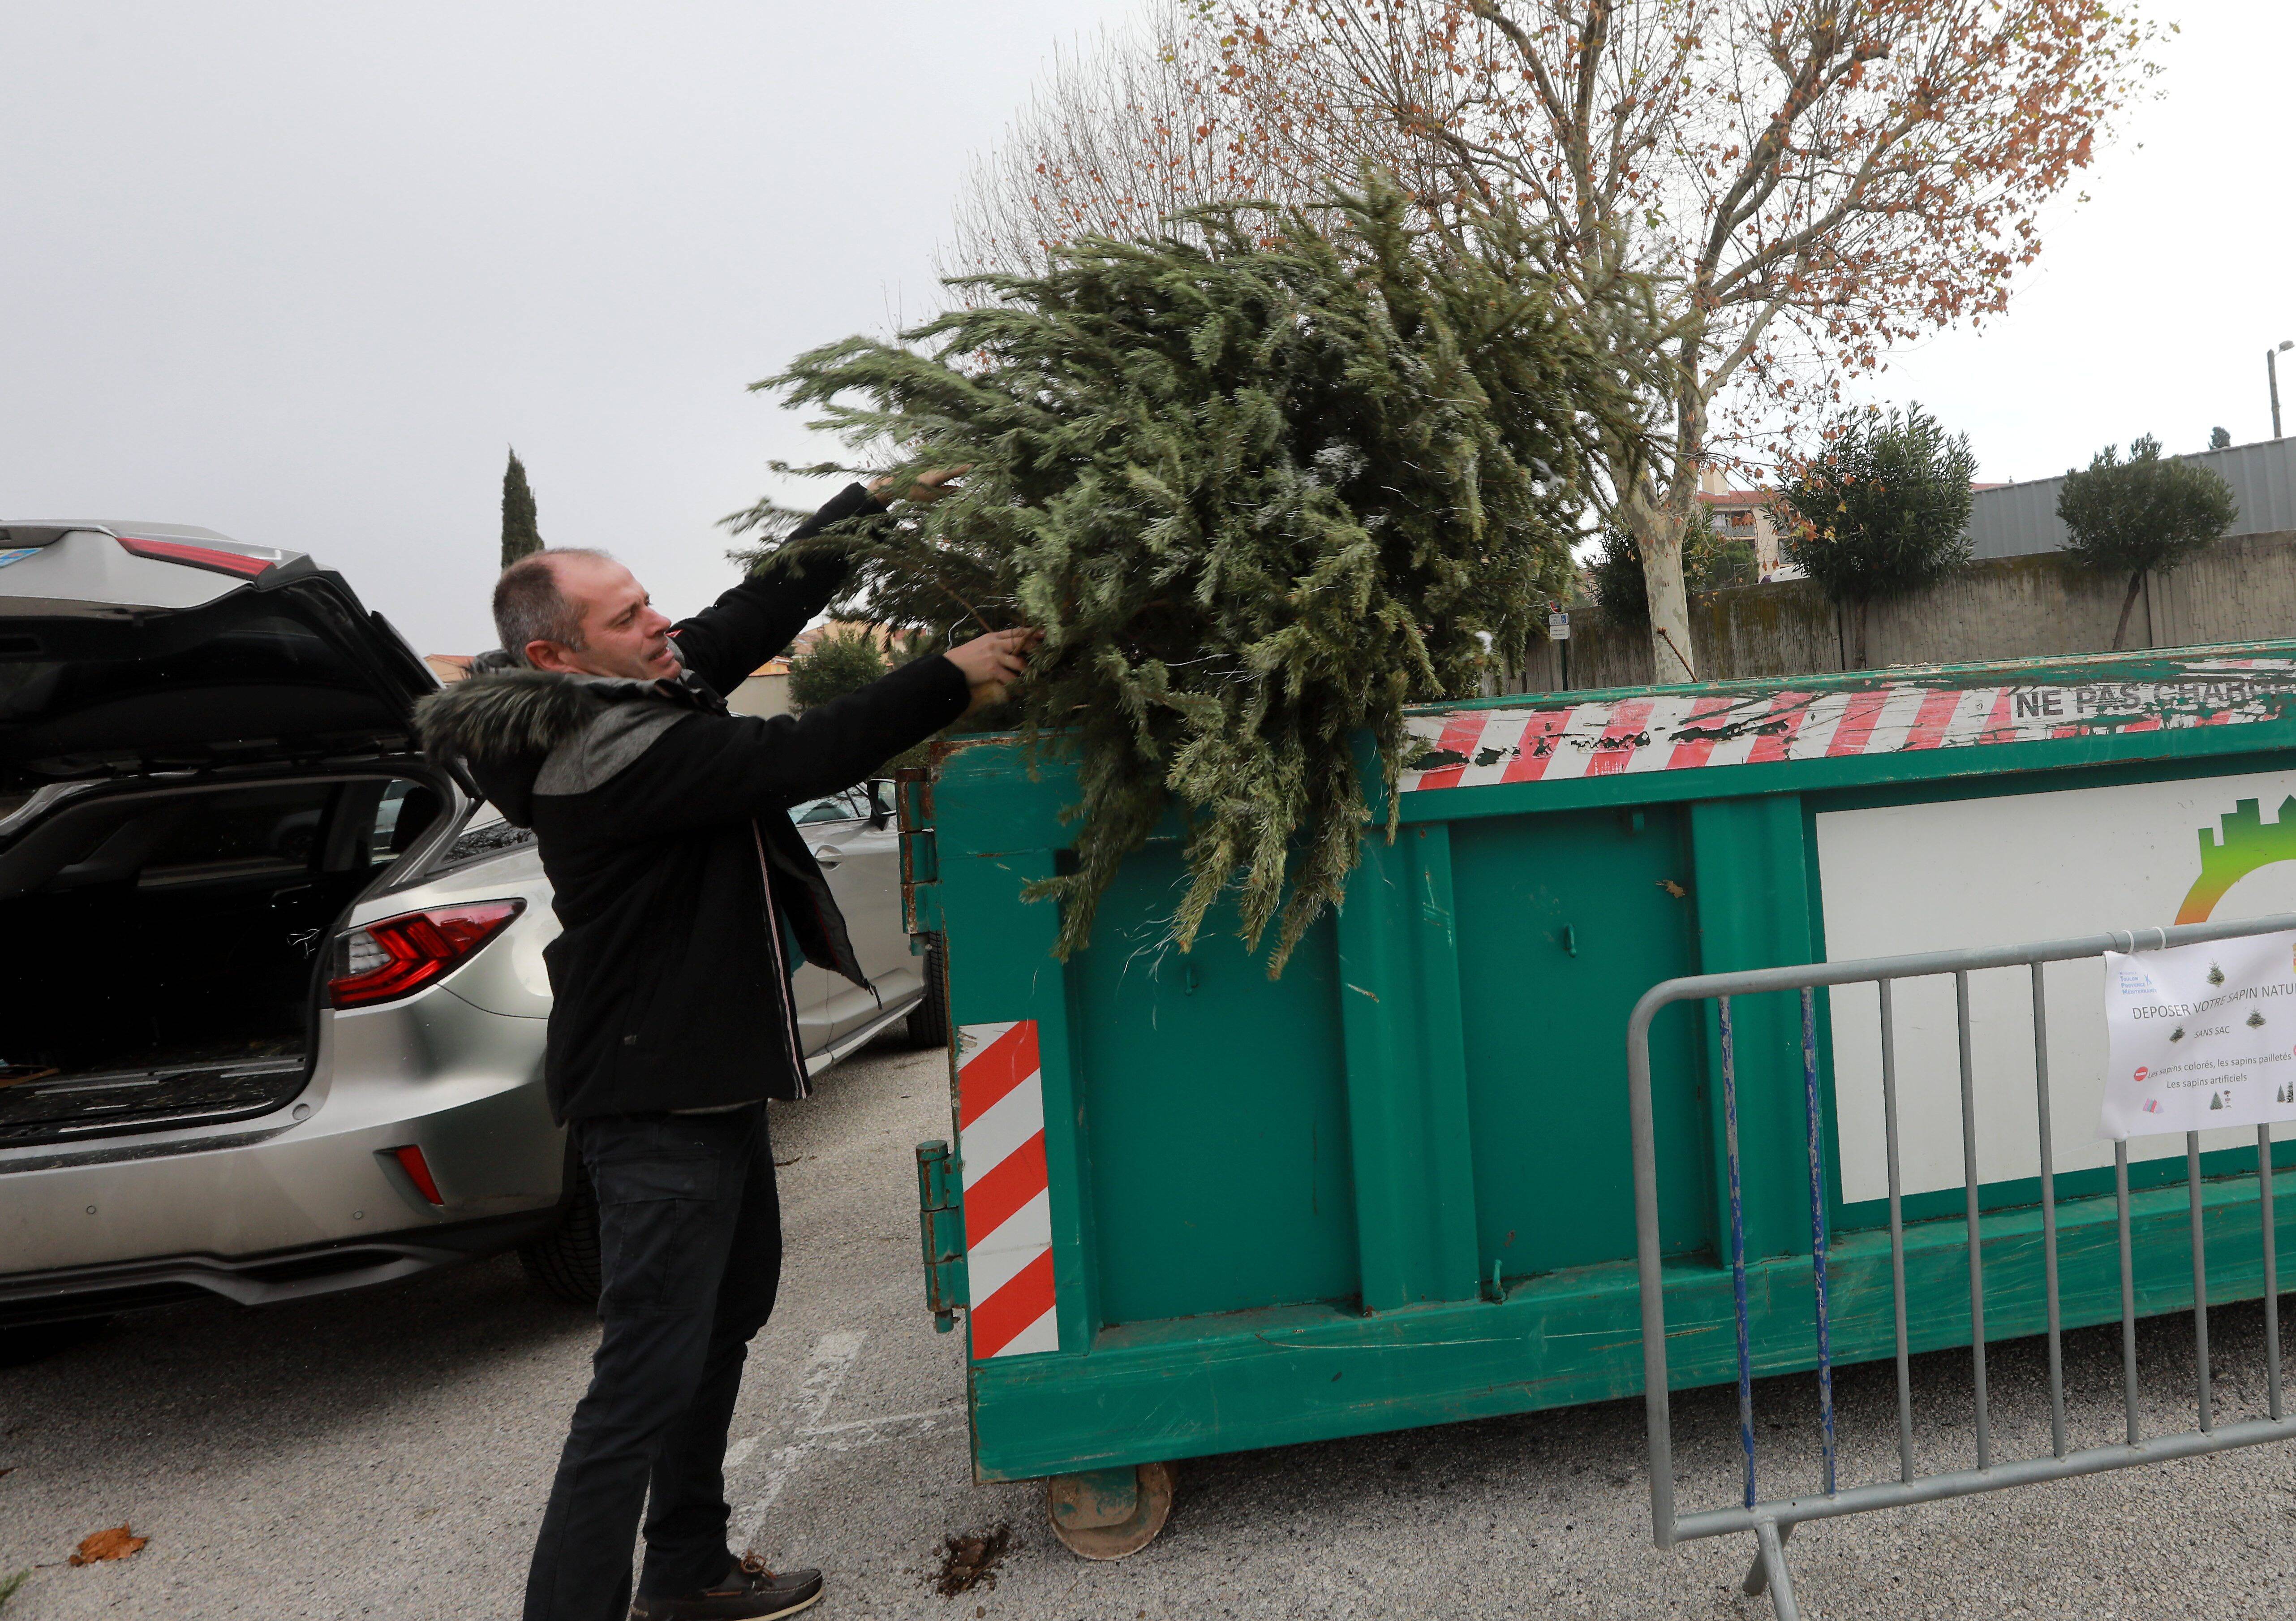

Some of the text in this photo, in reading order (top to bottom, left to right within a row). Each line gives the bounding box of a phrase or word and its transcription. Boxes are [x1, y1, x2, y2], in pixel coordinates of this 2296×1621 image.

[2017, 690, 2063, 718] NE
[2076, 685, 2141, 713] PAS
[2133, 983, 2296, 1019] DEPOSER VOTRE SAPIN NATU
[2194, 1026, 2230, 1039] SANS SAC
[2148, 1052, 2292, 1079] Les sapins colorés, les sapins pailletés
[2167, 1073, 2247, 1089] Les sapins artificiels
